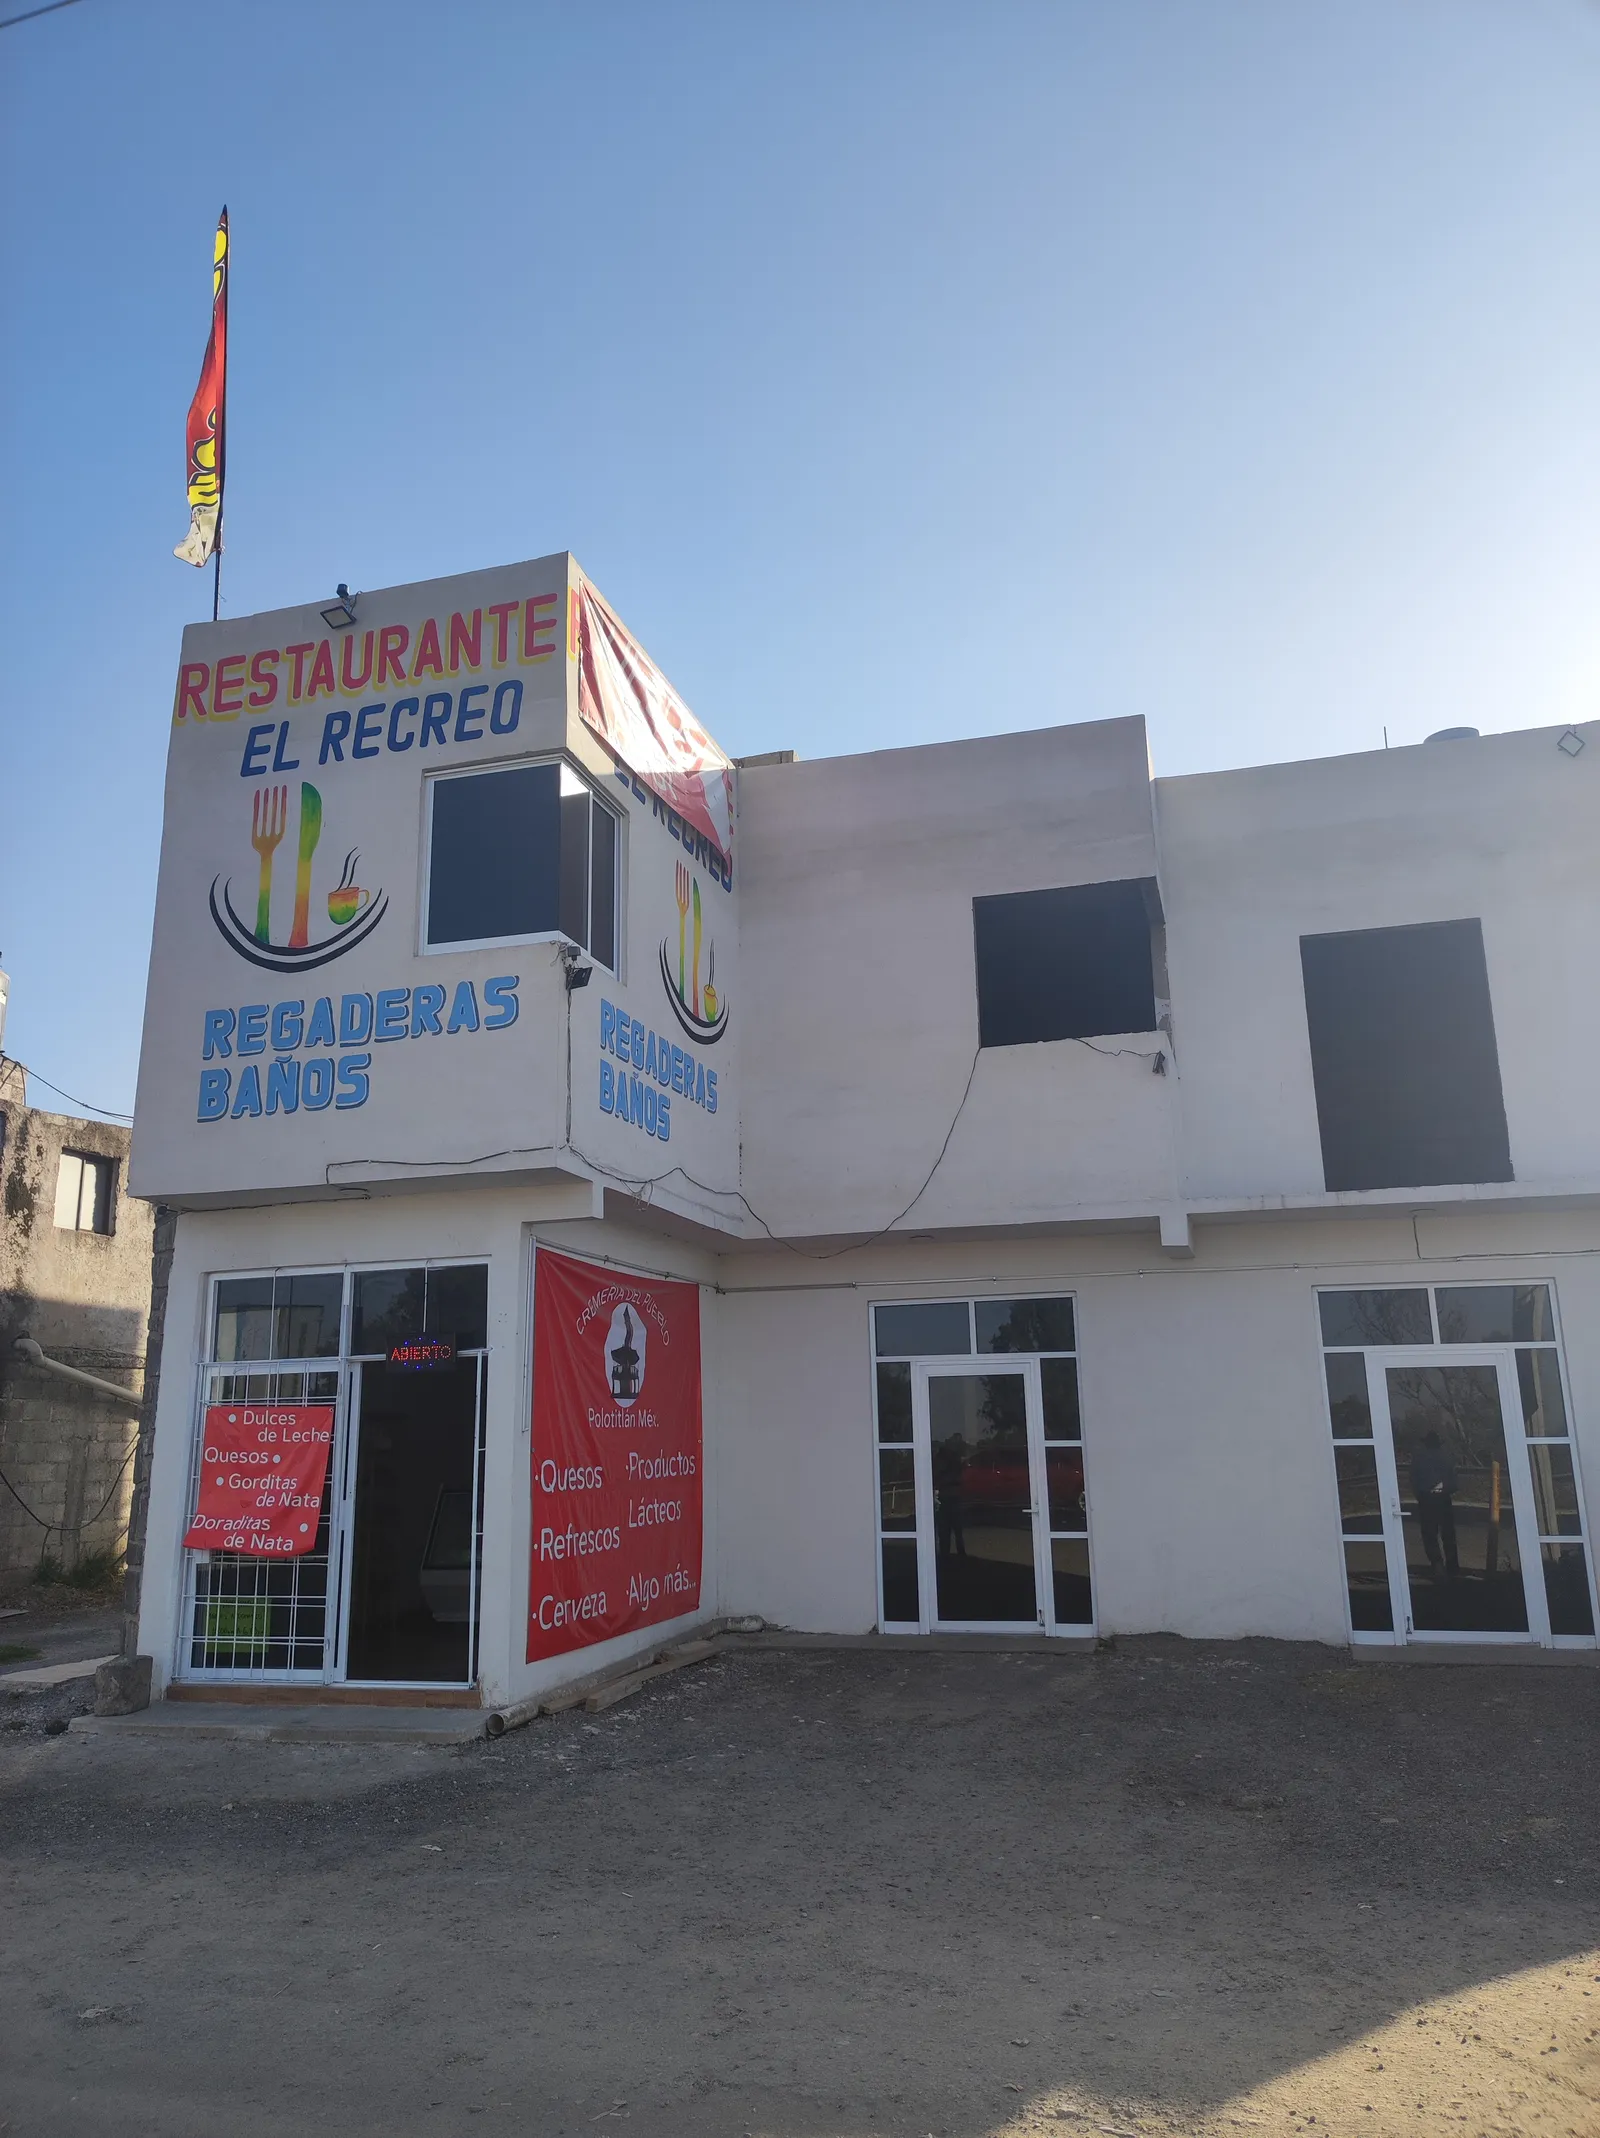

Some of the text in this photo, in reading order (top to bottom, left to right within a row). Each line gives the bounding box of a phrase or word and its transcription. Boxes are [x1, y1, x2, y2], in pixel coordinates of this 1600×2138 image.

[175, 593, 558, 724] RESTAURANTE
[240, 679, 524, 777] EL RECREO
[202, 975, 520, 1061] REGADERAS
[600, 998, 718, 1114] REGADERAS
[196, 1052, 372, 1123] BAÑOS
[599, 1058, 670, 1142] BAÑOS
[625, 1287, 642, 1304] DEL
[643, 1293, 670, 1346] PUEBLO
[391, 1345, 451, 1361] ABIERTO
[243, 1410, 296, 1425] Dulces
[588, 1407, 636, 1428] Polotitlán
[257, 1427, 330, 1442] de Leche
[204, 1447, 268, 1464] Quesos
[628, 1449, 696, 1480] Productos
[228, 1473, 298, 1490] Gorditas
[540, 1459, 603, 1493] Quesos
[256, 1492, 320, 1508] de Nata
[628, 1497, 682, 1528] Lácteos
[192, 1514, 271, 1531] Doraditas
[223, 1532, 294, 1551] de Nata
[540, 1523, 621, 1561] Refrescos
[628, 1572, 660, 1611] Algo
[538, 1590, 607, 1631] Cerveza
